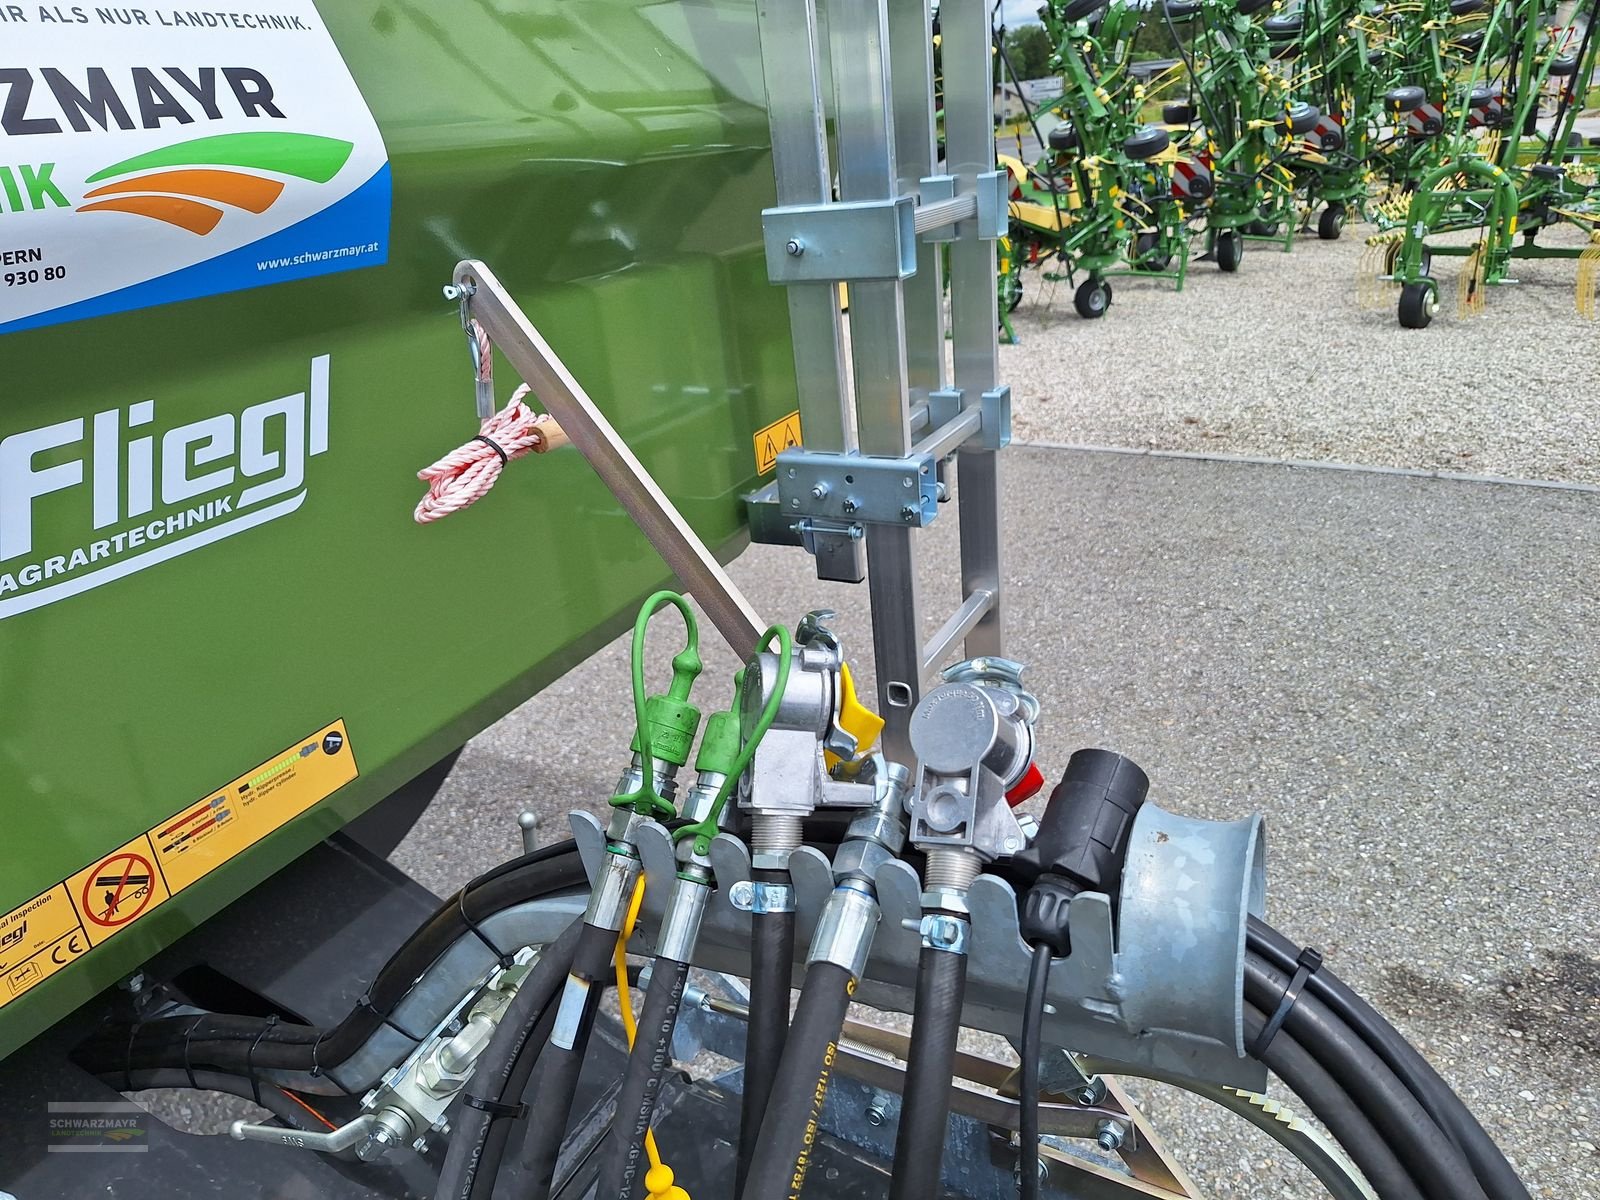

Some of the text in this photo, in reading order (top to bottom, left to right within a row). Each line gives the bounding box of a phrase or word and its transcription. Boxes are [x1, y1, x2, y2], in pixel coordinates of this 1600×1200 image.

[38, 5, 89, 24] ALS
[94, 7, 151, 25] NUR
[154, 9, 313, 31] LANDTECHNIK.
[0, 247, 42, 266] ERN
[256, 241, 379, 271] www.schwarzmayr.at
[4, 265, 66, 287] 930 80
[0, 353, 330, 562] Fliegl
[0, 495, 233, 596] AGRARTECHNIK
[10, 894, 53, 924] Inspection
[824, 1041, 838, 1067] ISO
[813, 1069, 831, 1109] 11237
[803, 1118, 818, 1145] ISO
[790, 1149, 809, 1190] 18752
